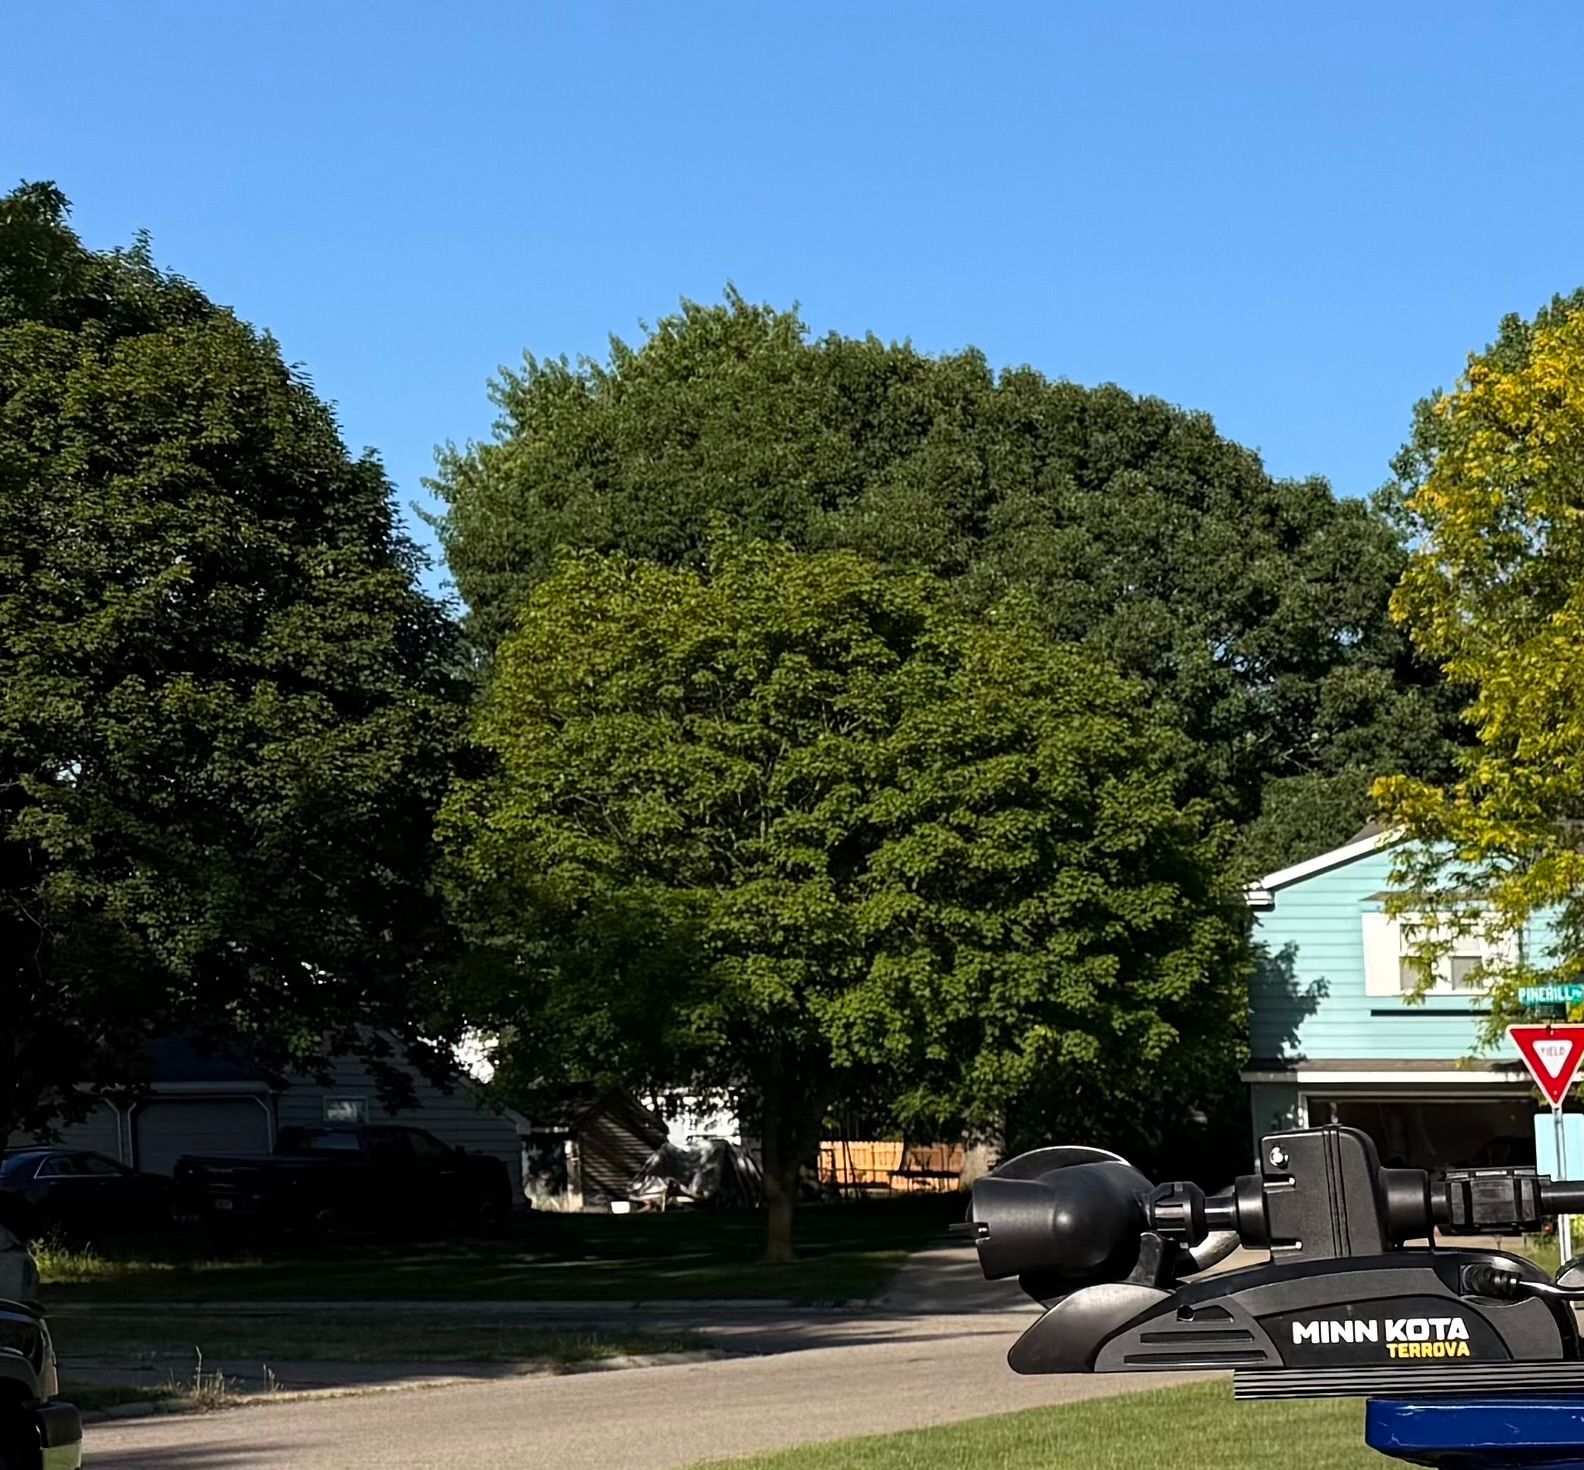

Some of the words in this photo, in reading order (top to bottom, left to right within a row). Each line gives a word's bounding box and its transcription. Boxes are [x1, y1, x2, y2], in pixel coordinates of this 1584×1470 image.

[1541, 1046, 1566, 1057] YIELD
[1292, 1319, 1379, 1344] MINN
[1385, 1317, 1470, 1342] KOTA
[1386, 1341, 1471, 1358] TERROVA
